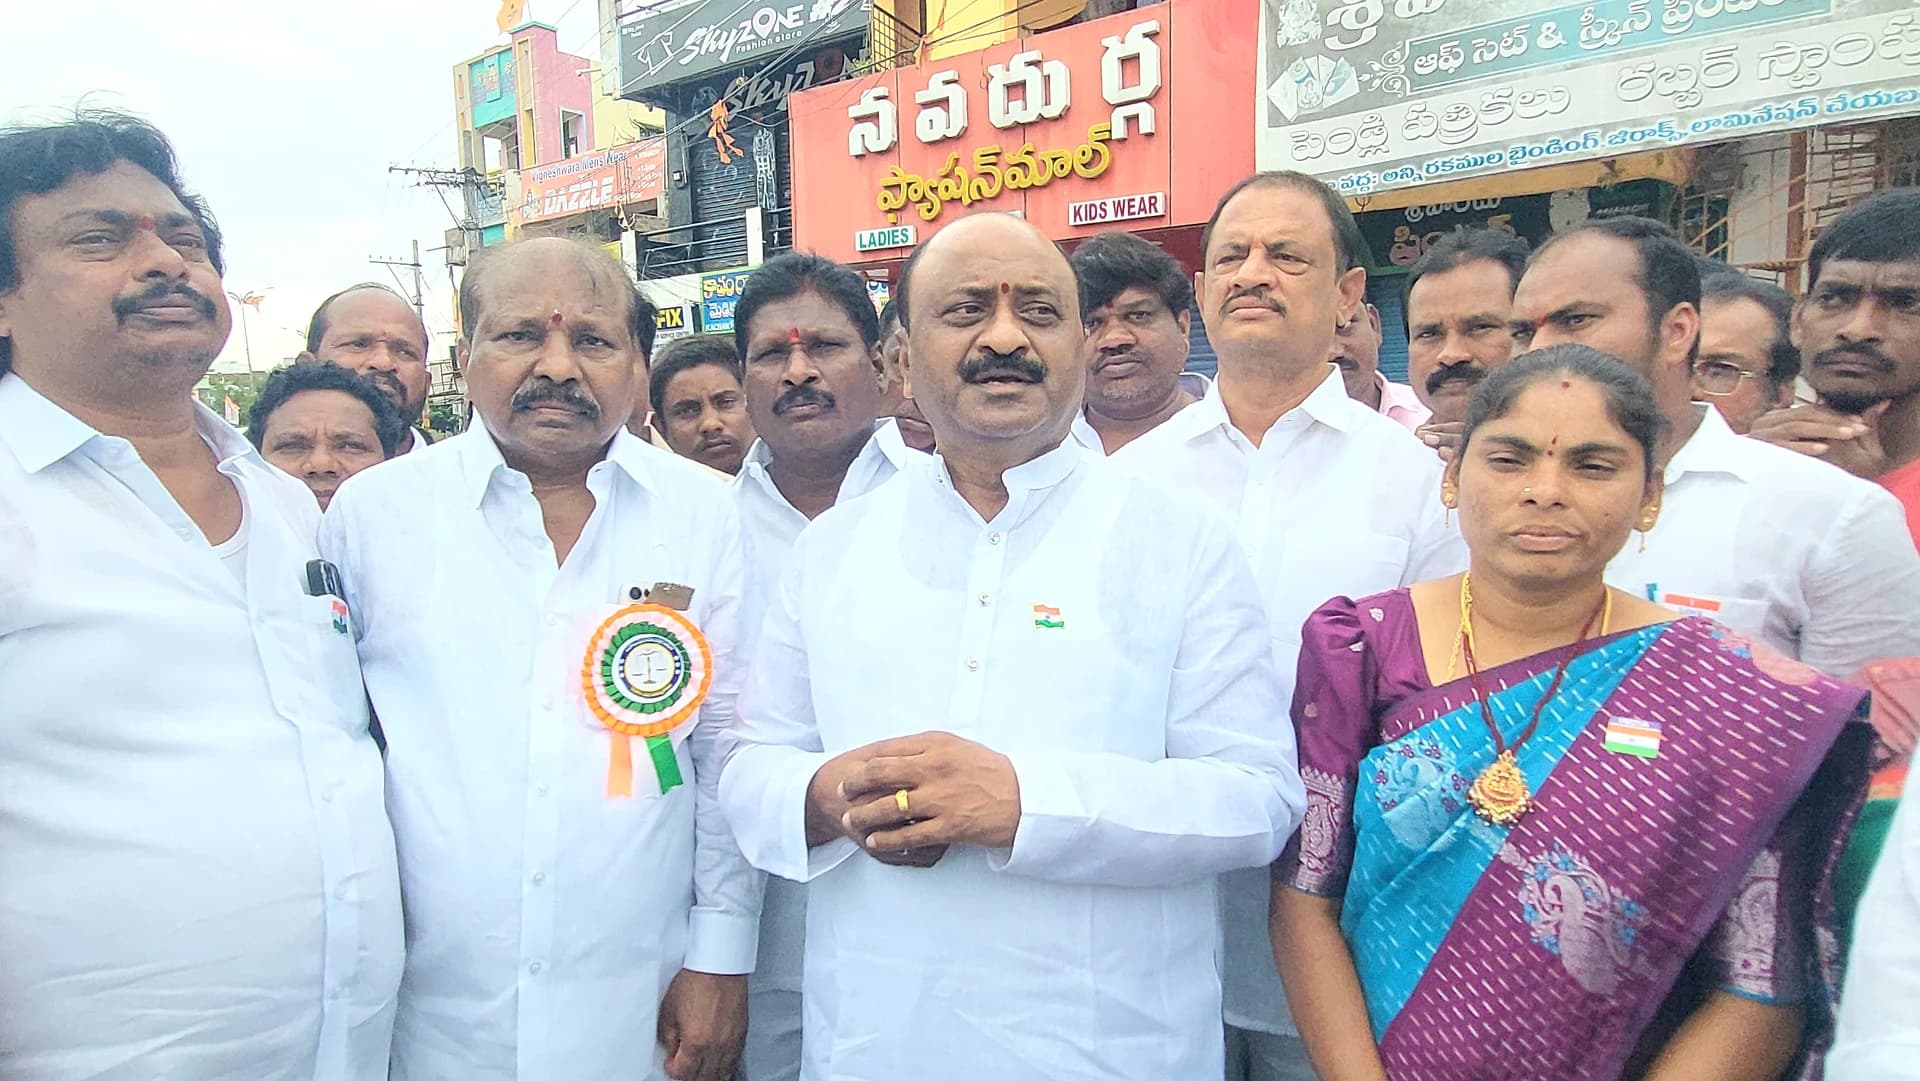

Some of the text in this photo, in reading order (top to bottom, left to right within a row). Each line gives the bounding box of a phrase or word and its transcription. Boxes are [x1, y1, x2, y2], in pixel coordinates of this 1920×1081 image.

[1537, 21, 1567, 49] &
[544, 176, 614, 215] DAZZLE
[1073, 195, 1158, 223] KIDS WEAR
[859, 228, 909, 249] LADIES
